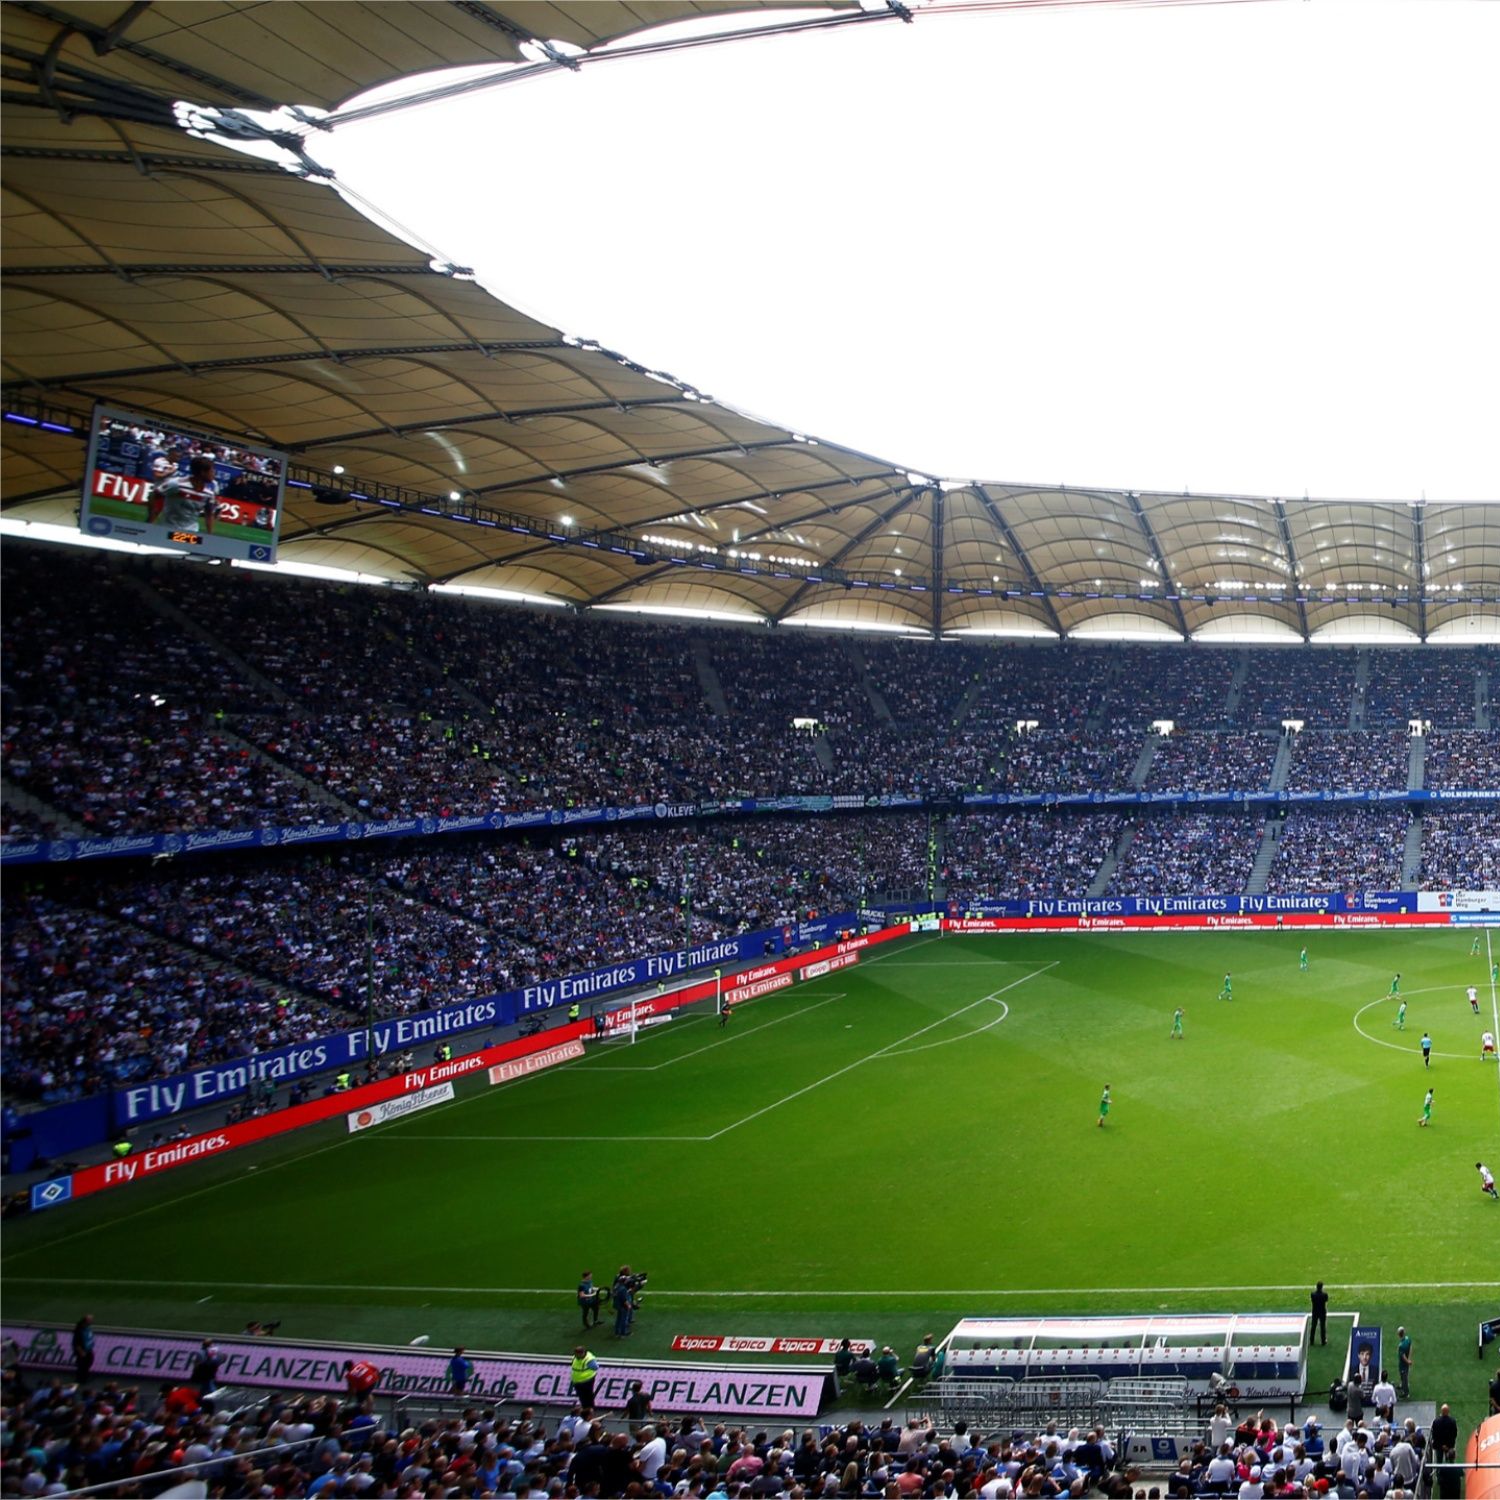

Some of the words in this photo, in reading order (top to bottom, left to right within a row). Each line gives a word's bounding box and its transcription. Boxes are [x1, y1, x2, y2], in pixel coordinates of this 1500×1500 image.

[97, 473, 139, 501] Fly
[1029, 900, 1054, 915] Fly
[1058, 899, 1123, 912] Emirates
[1136, 898, 1160, 912] Fly
[1163, 897, 1227, 911] Emirates
[1240, 896, 1264, 912] Fly
[1267, 896, 1329, 909] Emirates
[949, 919, 962, 930] Fly
[1078, 918, 1091, 927] Fly
[1207, 916, 1219, 926] Fly
[1334, 915, 1345, 924] Fly
[648, 956, 673, 976] Fly
[677, 941, 739, 966] Emirates
[523, 988, 555, 1008] Fly
[560, 966, 636, 1000] Emirates
[732, 987, 750, 1001] Fly
[750, 975, 792, 993] Emirates
[736, 974, 748, 985] Fly
[348, 1028, 390, 1057] Fly
[397, 1001, 496, 1044] Emirates
[500, 1062, 524, 1080] Fly
[526, 1044, 582, 1068] Emirates
[126, 1082, 185, 1119] Fly
[194, 1045, 327, 1100] Emirates
[404, 1072, 426, 1089] Fly
[380, 1098, 414, 1120] König
[410, 1084, 450, 1106] Pilsener
[105, 1161, 138, 1184] Fly
[680, 1336, 717, 1351] tipico
[729, 1336, 766, 1351] tipico
[778, 1338, 816, 1353] tipico
[218, 1352, 348, 1382] FLANZEN
[651, 1378, 807, 1408] PFLANZEN
